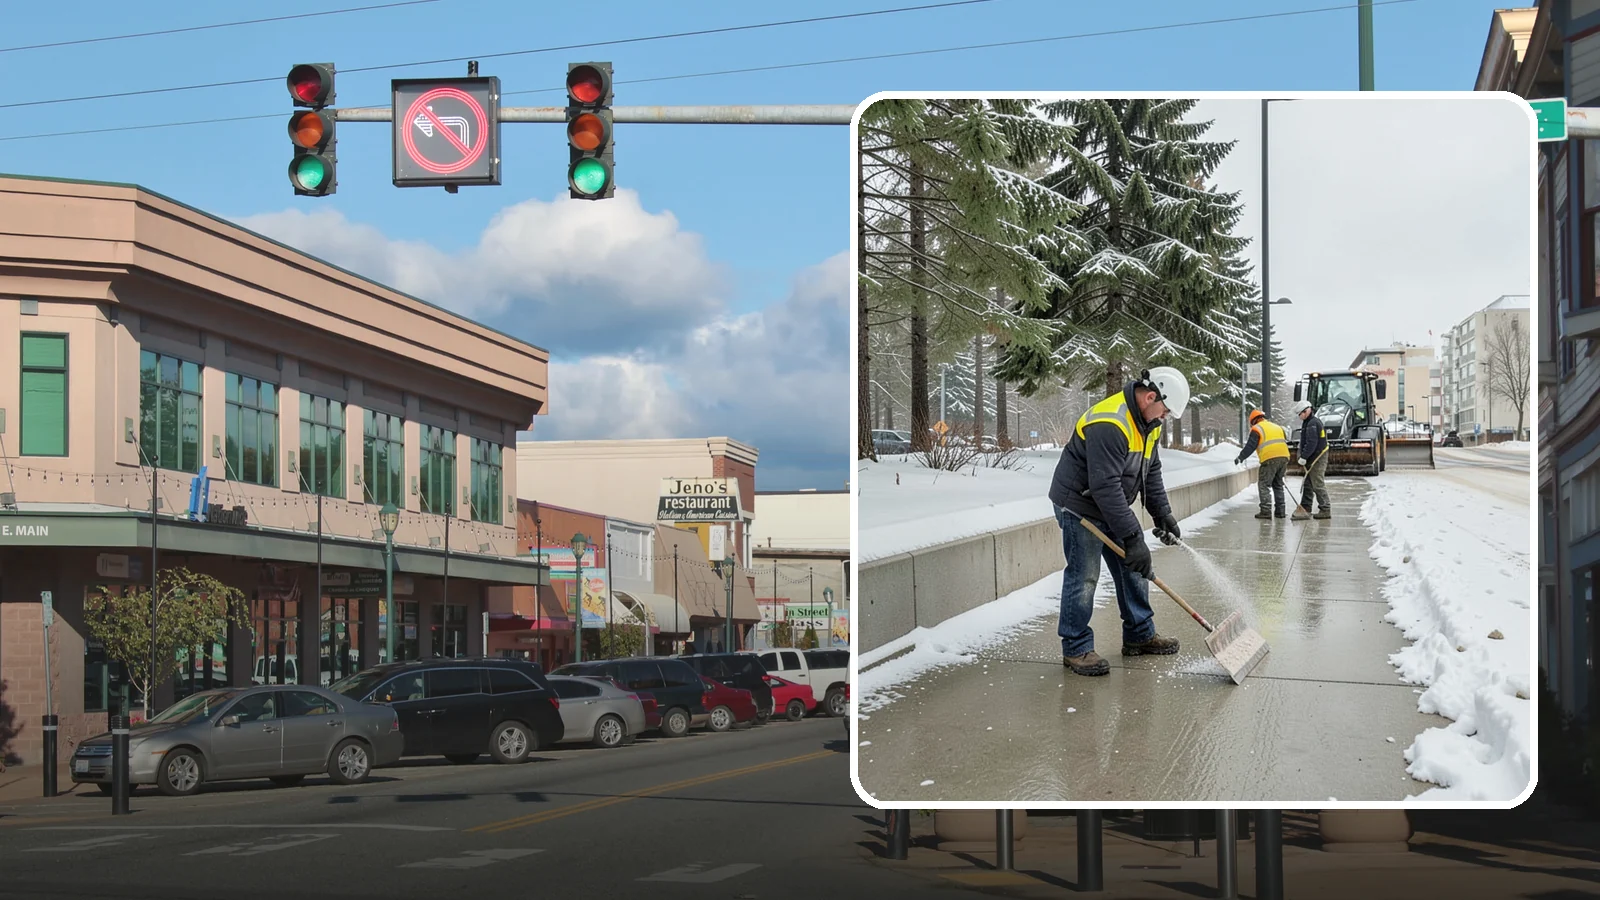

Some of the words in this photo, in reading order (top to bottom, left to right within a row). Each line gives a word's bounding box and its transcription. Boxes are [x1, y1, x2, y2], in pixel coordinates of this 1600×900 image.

[670, 480, 727, 494] Jeno's
[665, 497, 731, 509] restaurant
[659, 510, 681, 519] Italian
[686, 510, 714, 519] American
[715, 510, 737, 519] Cuisine
[2, 525, 13, 536] E.
[15, 525, 49, 536] MAIN
[797, 608, 828, 616] Street
